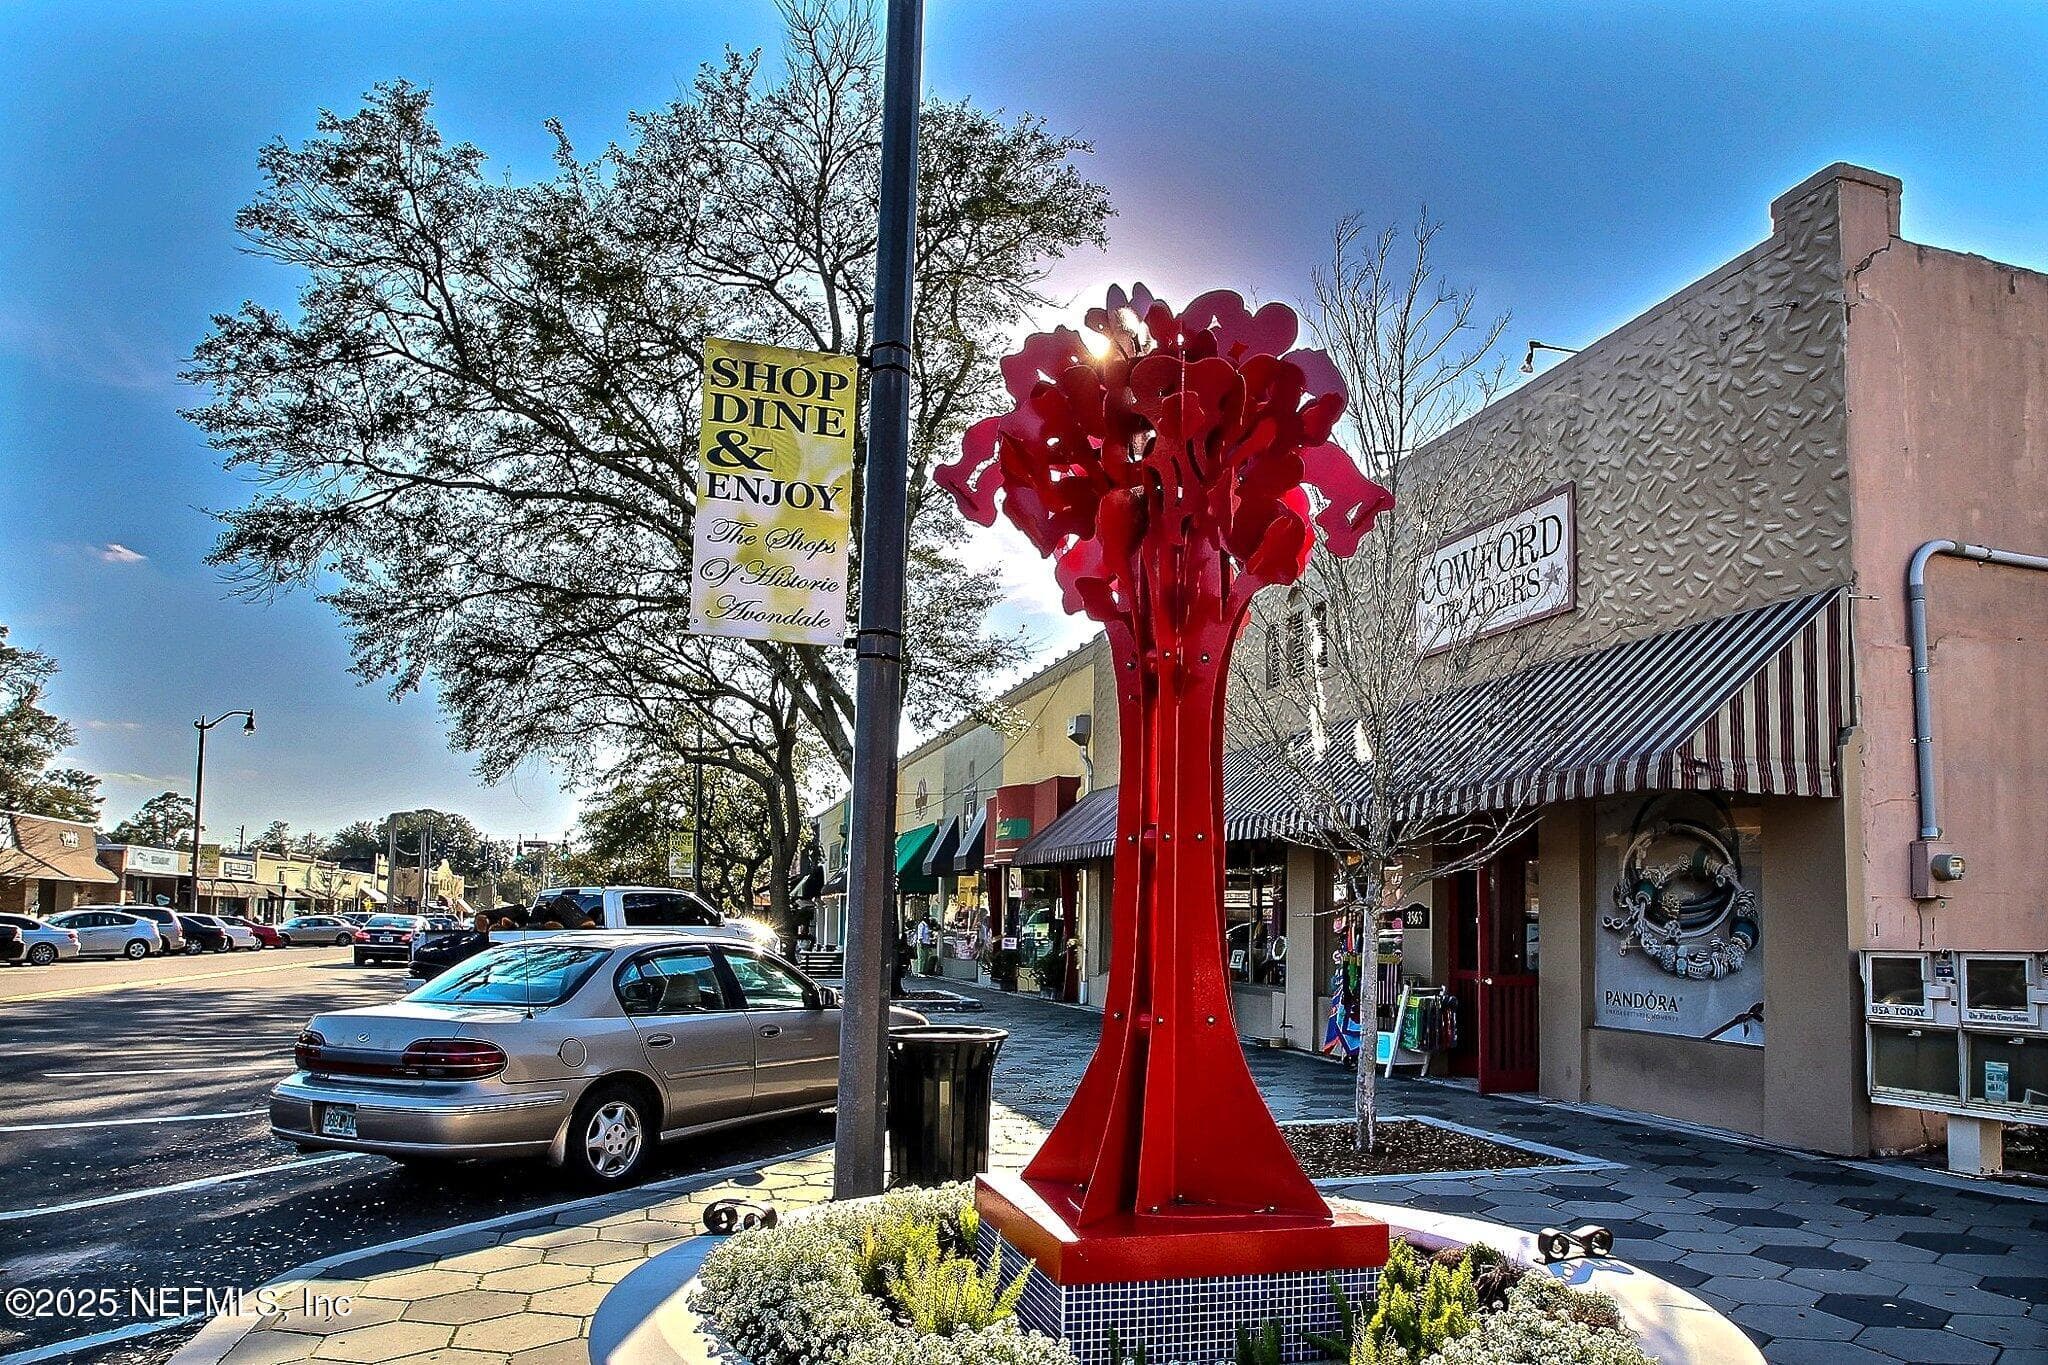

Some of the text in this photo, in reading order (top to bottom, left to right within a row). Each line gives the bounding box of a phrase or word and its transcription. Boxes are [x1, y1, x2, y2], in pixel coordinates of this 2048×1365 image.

[709, 357, 849, 401] SHOP
[708, 394, 847, 438] DINE
[706, 430, 774, 472] &
[704, 472, 843, 512] ENJOY
[706, 518, 837, 560] The Shops
[1420, 515, 1563, 604] COWFORD
[699, 557, 840, 594] Of Historic
[705, 595, 831, 629] Avondale
[1436, 568, 1542, 628] TRADERS
[1605, 990, 1679, 1013] PANDORA
[1871, 1006, 1925, 1017] USA TODAY
